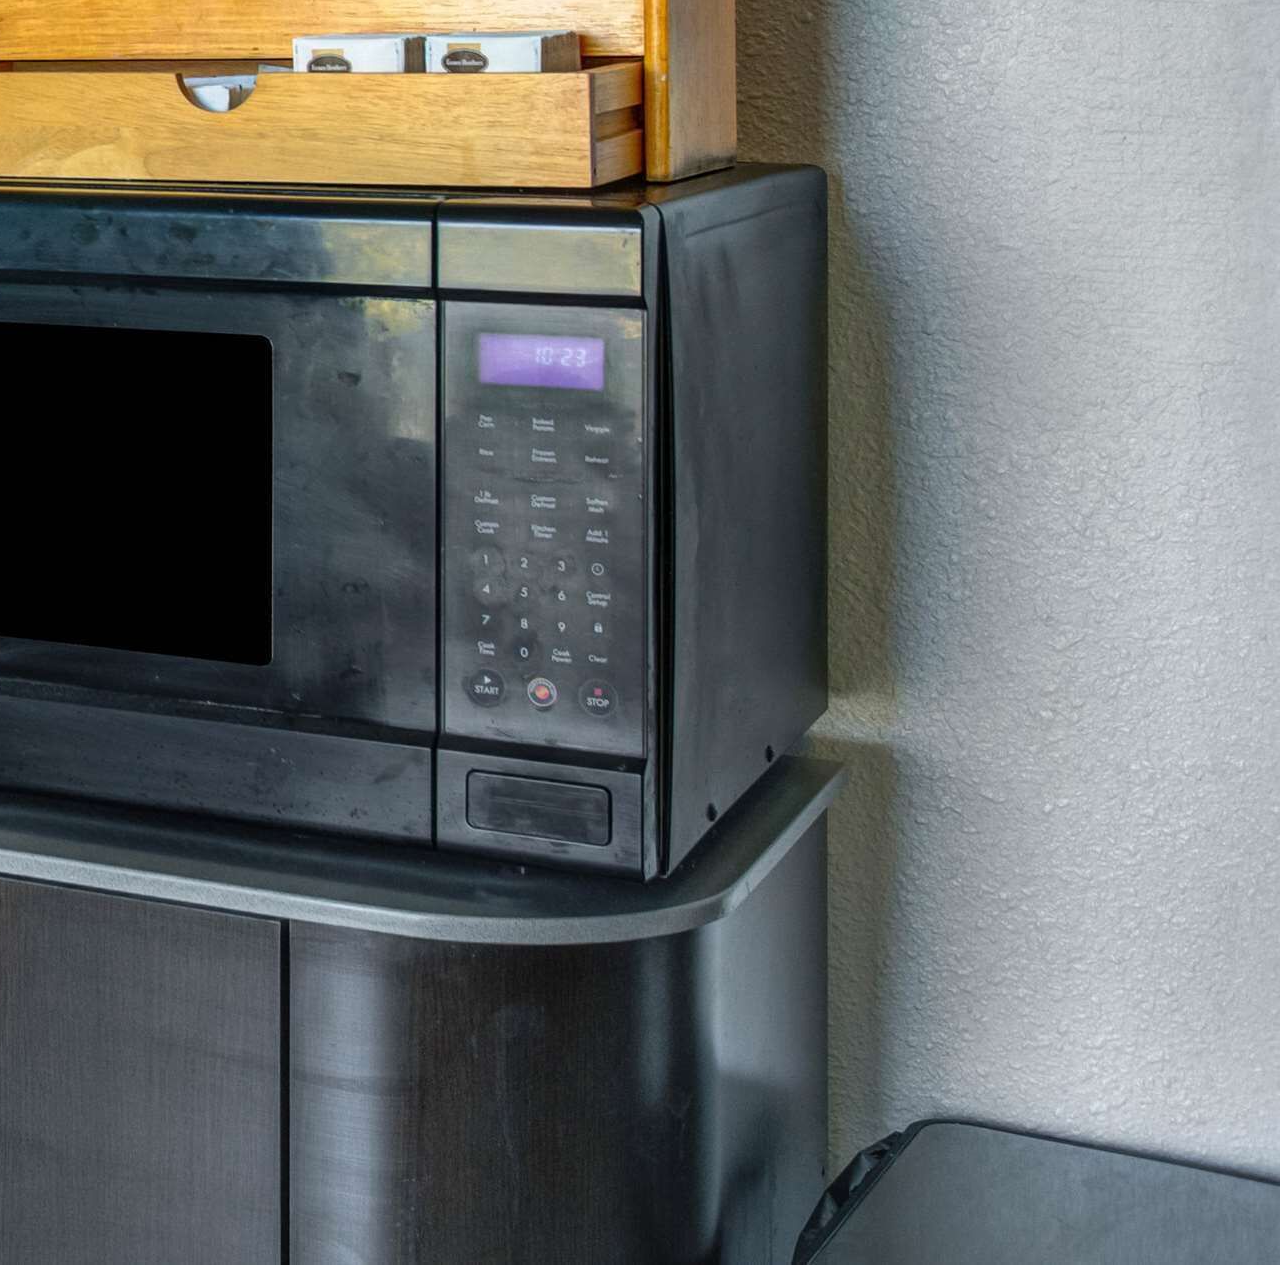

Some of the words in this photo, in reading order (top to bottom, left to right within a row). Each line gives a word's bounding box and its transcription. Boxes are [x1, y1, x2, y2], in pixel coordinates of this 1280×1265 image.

[483, 554, 489, 565] 1
[521, 557, 528, 568] 2
[558, 561, 566, 572] 3
[482, 583, 490, 594] 4
[521, 587, 528, 598] 5
[558, 590, 566, 601] 6
[482, 615, 491, 626] 7
[521, 618, 528, 629] 8
[558, 622, 566, 632] 9
[520, 647, 529, 658] 0
[474, 685, 500, 695] START
[586, 697, 610, 708] STOP
